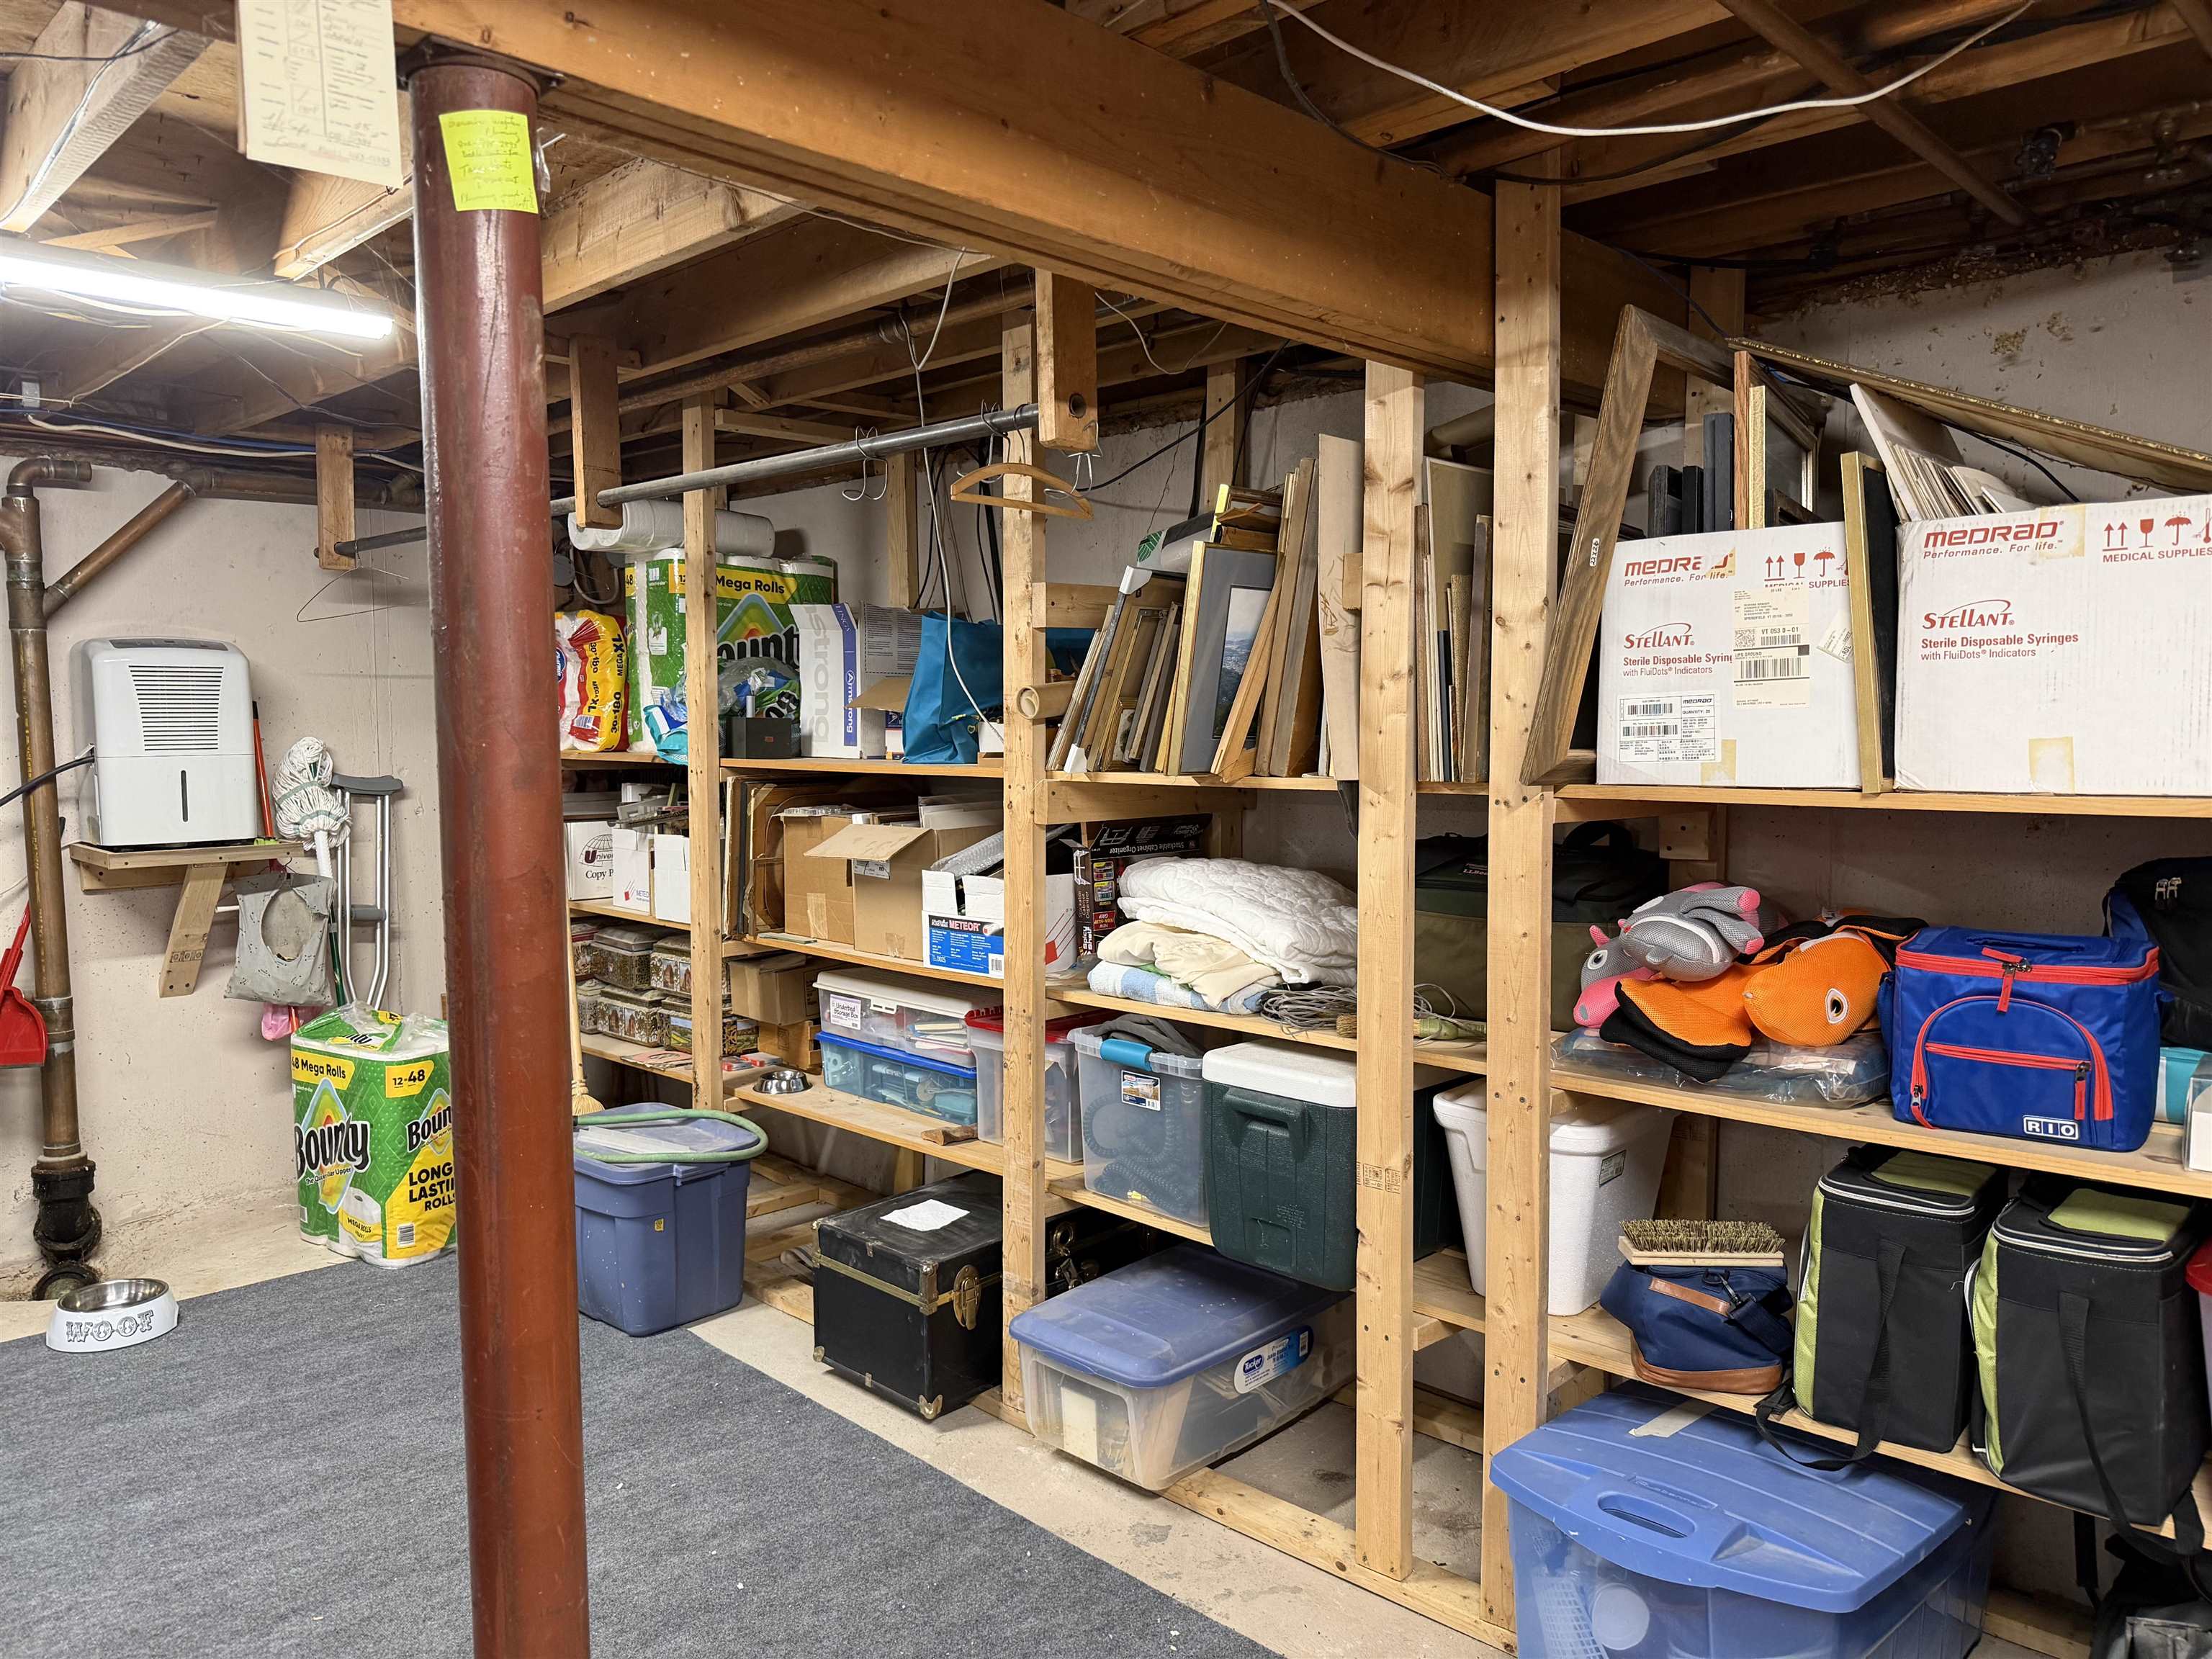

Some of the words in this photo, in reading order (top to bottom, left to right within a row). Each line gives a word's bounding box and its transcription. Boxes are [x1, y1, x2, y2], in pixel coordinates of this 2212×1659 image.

[1923, 548, 2002, 559] Performance.
[2009, 544, 2029, 552] For
[2103, 552, 2154, 562] MEDICAL
[2157, 547, 2212, 559] SUPPLIES
[716, 575, 751, 590] Mega
[755, 579, 786, 594] Rolls
[1624, 576, 1683, 586] Performance.
[611, 634, 625, 653] XL
[717, 625, 801, 670] ount
[1921, 638, 1957, 649] Sterile
[1961, 635, 2023, 649] Disposable
[2027, 633, 2079, 647] Syringes
[1623, 657, 1650, 666] Sterile
[1653, 654, 1702, 667] Disposable
[1921, 651, 1941, 660] with
[1989, 649, 2036, 658] Indicators
[1623, 668, 1639, 677] with
[1674, 665, 1713, 675] Indicators
[588, 697, 599, 714] XL
[844, 670, 855, 734] Armsrong
[1110, 845, 1136, 855] Organizer
[1137, 842, 1159, 852] Cabinet
[1159, 841, 1184, 850] Stackable
[585, 870, 606, 880] Copy
[948, 919, 979, 935] METEOR
[301, 1058, 325, 1076] Mega
[326, 1064, 346, 1079] Rolls
[2026, 1119, 2076, 1137] RIO
[294, 1115, 369, 1178] Bounty
[66, 1309, 154, 1343] WOOF
